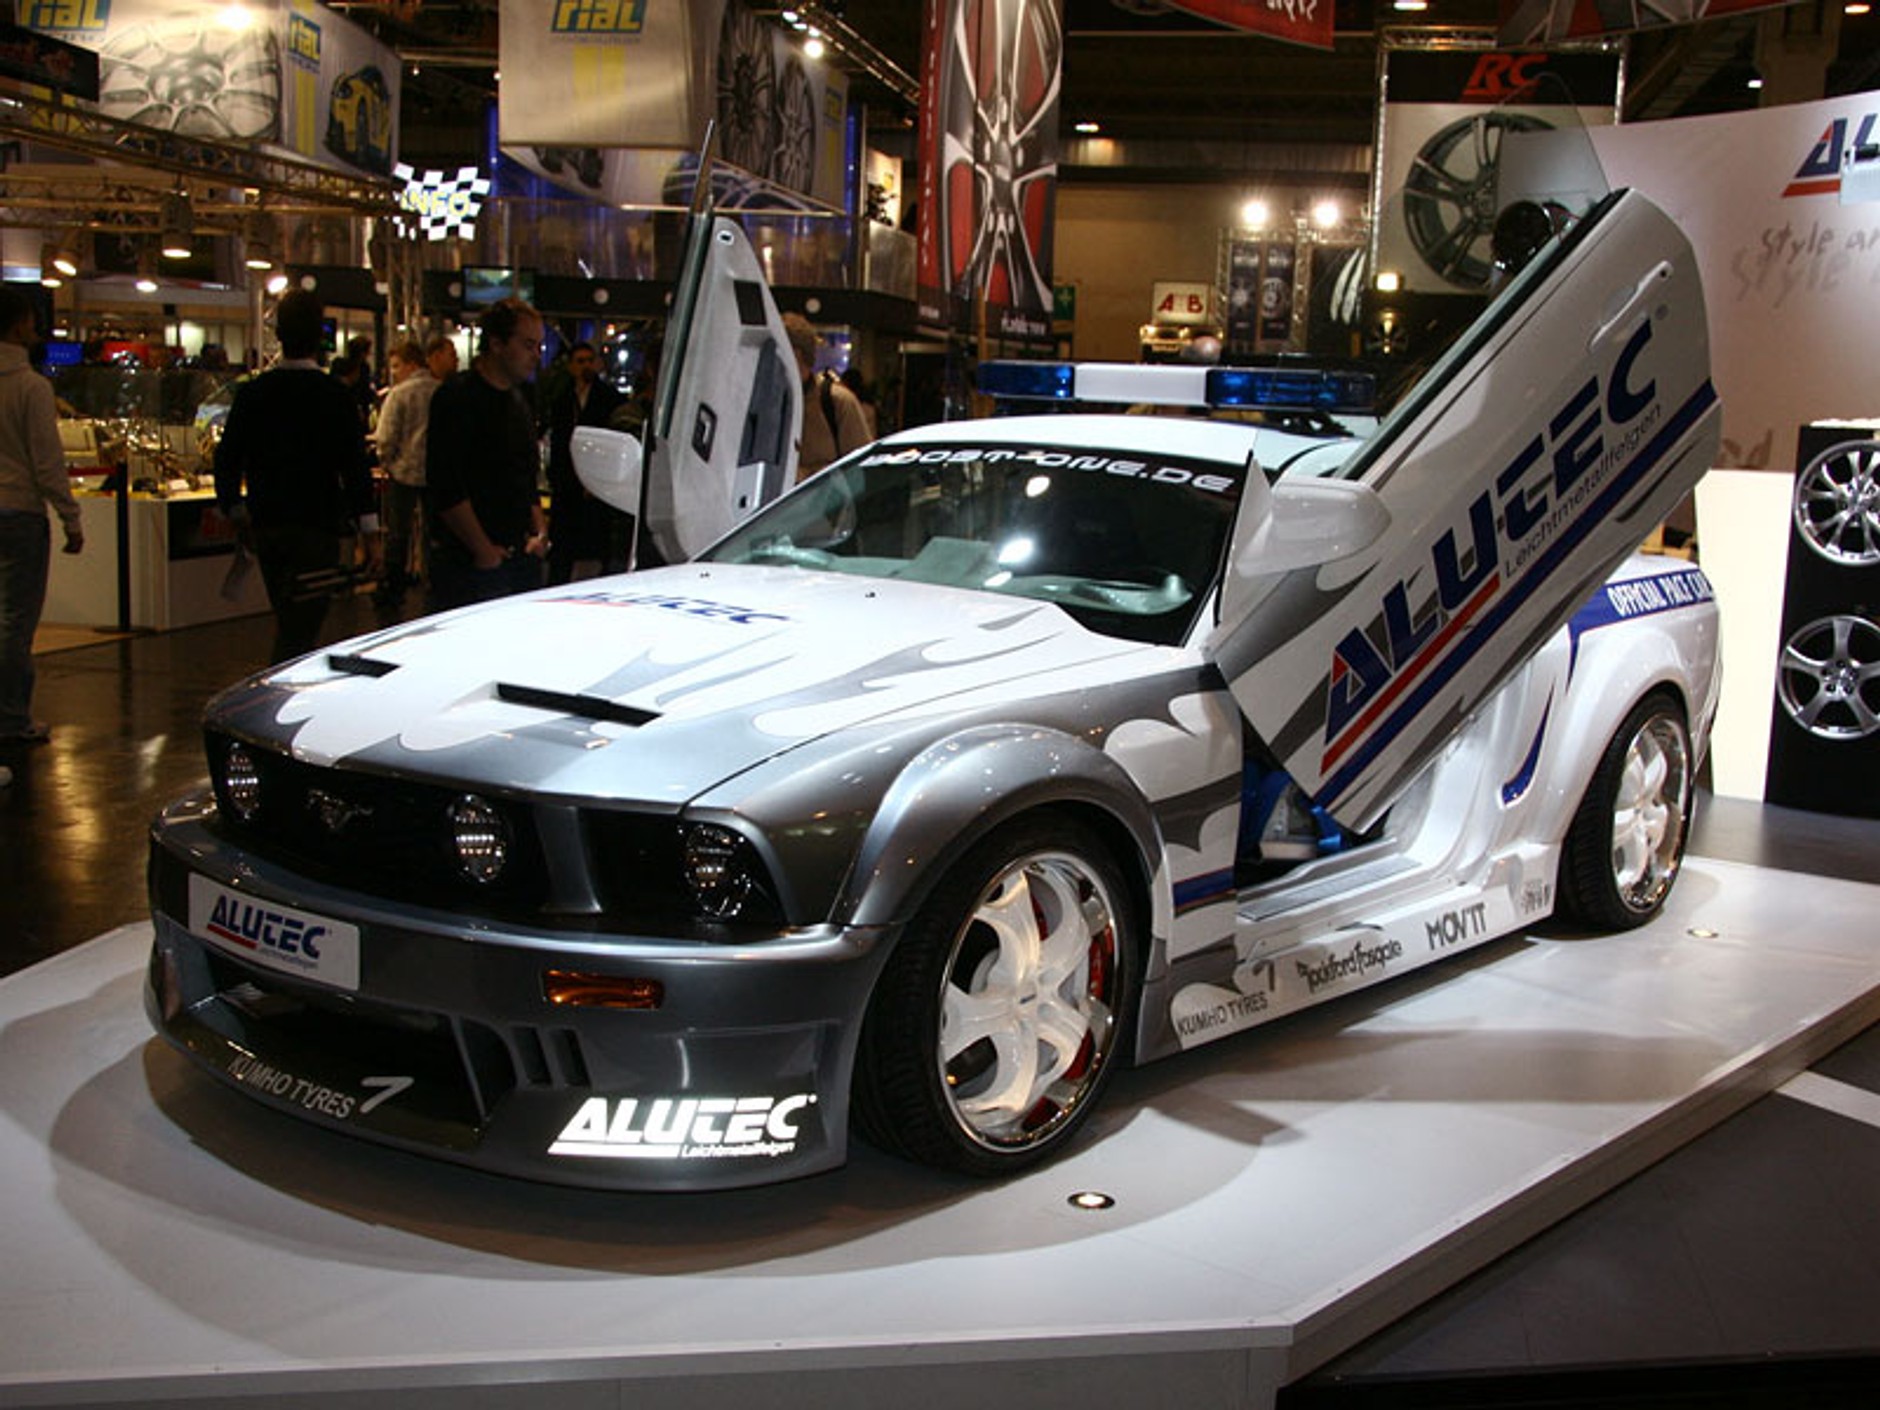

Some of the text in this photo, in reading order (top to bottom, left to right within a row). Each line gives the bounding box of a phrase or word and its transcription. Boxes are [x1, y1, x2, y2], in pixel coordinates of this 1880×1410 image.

[1464, 53, 1548, 95] RC
[1324, 318, 1657, 744] ALUTEC
[1607, 580, 1667, 617] OFFICIAL
[209, 894, 327, 960] ALUTEC
[1178, 991, 1268, 1036] KUMHO TYRES
[227, 1055, 356, 1119] KUMHO TYRES
[556, 1094, 810, 1144] ALUTEC
